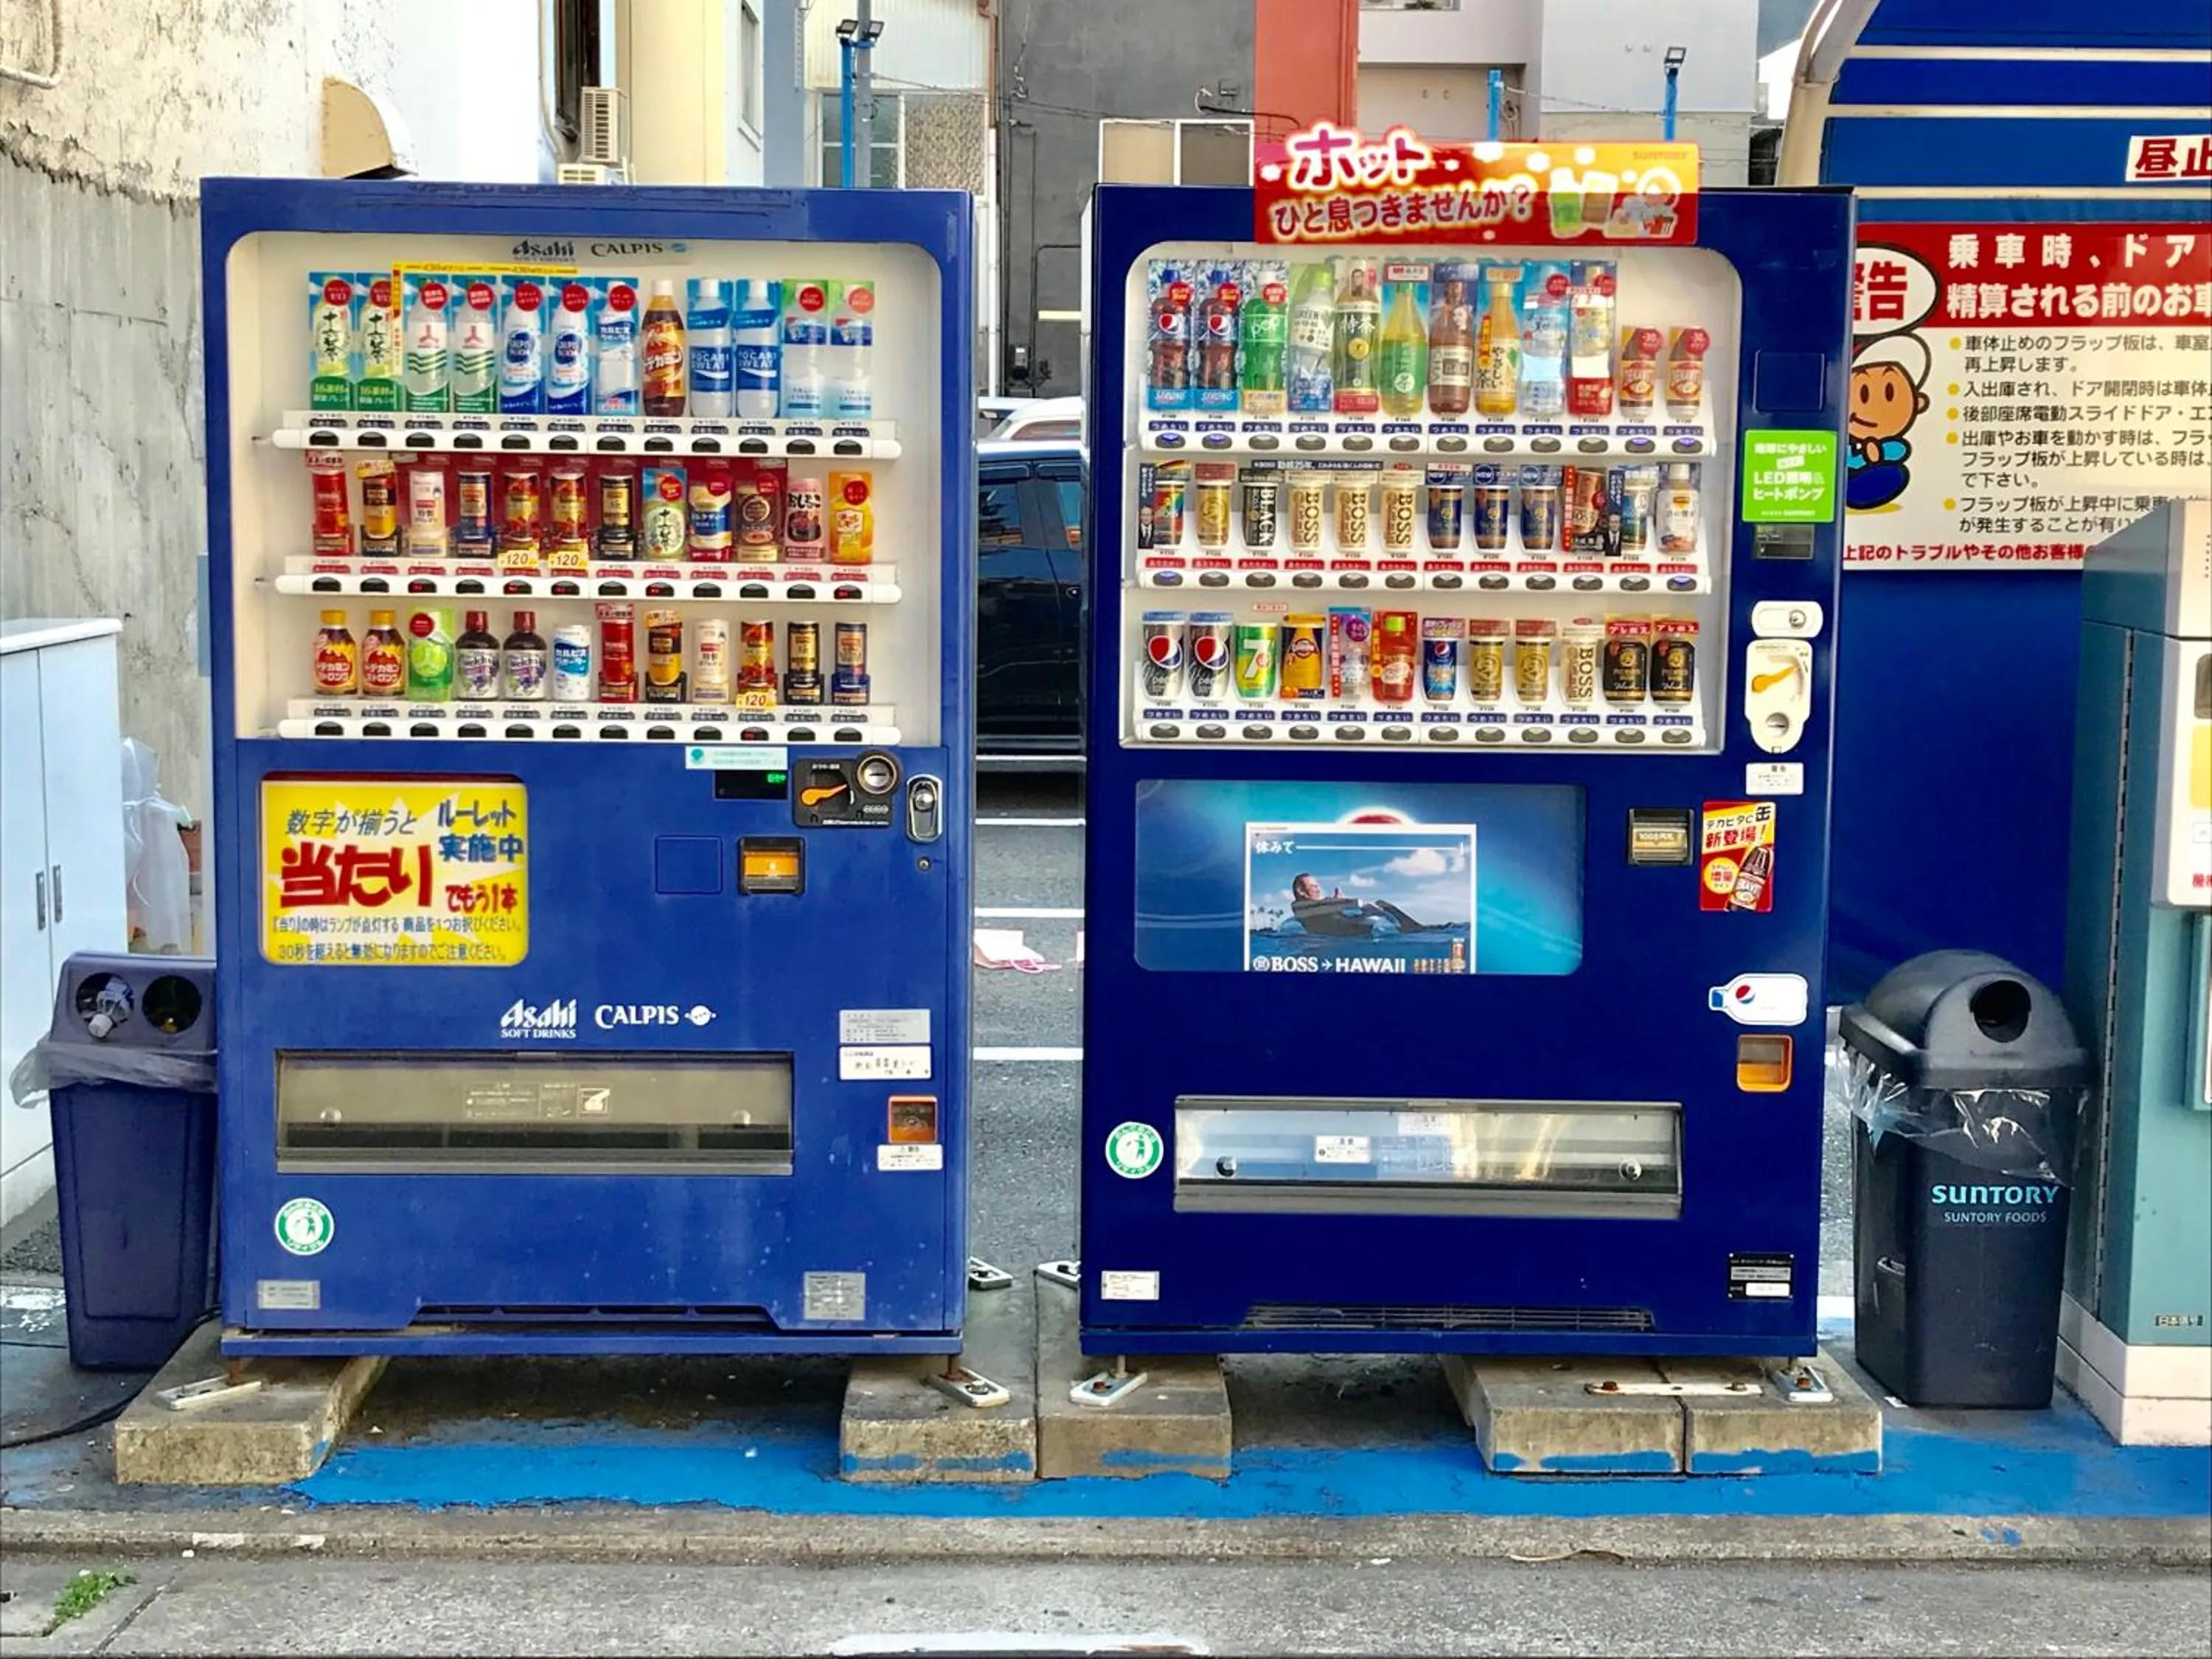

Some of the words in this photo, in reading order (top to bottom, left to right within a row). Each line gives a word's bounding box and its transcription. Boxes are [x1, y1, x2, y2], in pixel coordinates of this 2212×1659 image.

[1292, 127, 1427, 189] ホット
[512, 240, 574, 257] Asahi
[591, 242, 664, 257] CALPIS
[1964, 334, 2211, 352] 車体止めのフラップ板は、車室
[1964, 355, 2078, 373] 再上昇します。
[1964, 380, 2211, 397] 入出庫され、ドア開閉時は車体
[1961, 472, 2039, 489] で下さい。
[1259, 488, 1276, 544] BLACK
[1303, 491, 1320, 543] BOSS
[1350, 492, 1367, 544] BOSS
[1396, 493, 1413, 546] BOSS
[1578, 647, 1594, 698] BOSS
[285, 809, 418, 836] 数字が揃うと
[437, 799, 516, 828] ルーレット
[437, 833, 524, 863] 実施中
[1705, 824, 1767, 849] 新登場!
[280, 841, 434, 908] 当たり
[1270, 956, 1318, 972] BOSS
[1335, 958, 1406, 973] HAWAII
[501, 998, 577, 1029] Asahi
[594, 1004, 680, 1029] CALPIS
[501, 1028, 531, 1039] SOFT
[533, 1028, 577, 1039] DRINKS
[1931, 1183, 2059, 1205] SUNTORY
[1944, 1211, 2002, 1224] SUNTORY
[2005, 1211, 2048, 1223] FOODS
